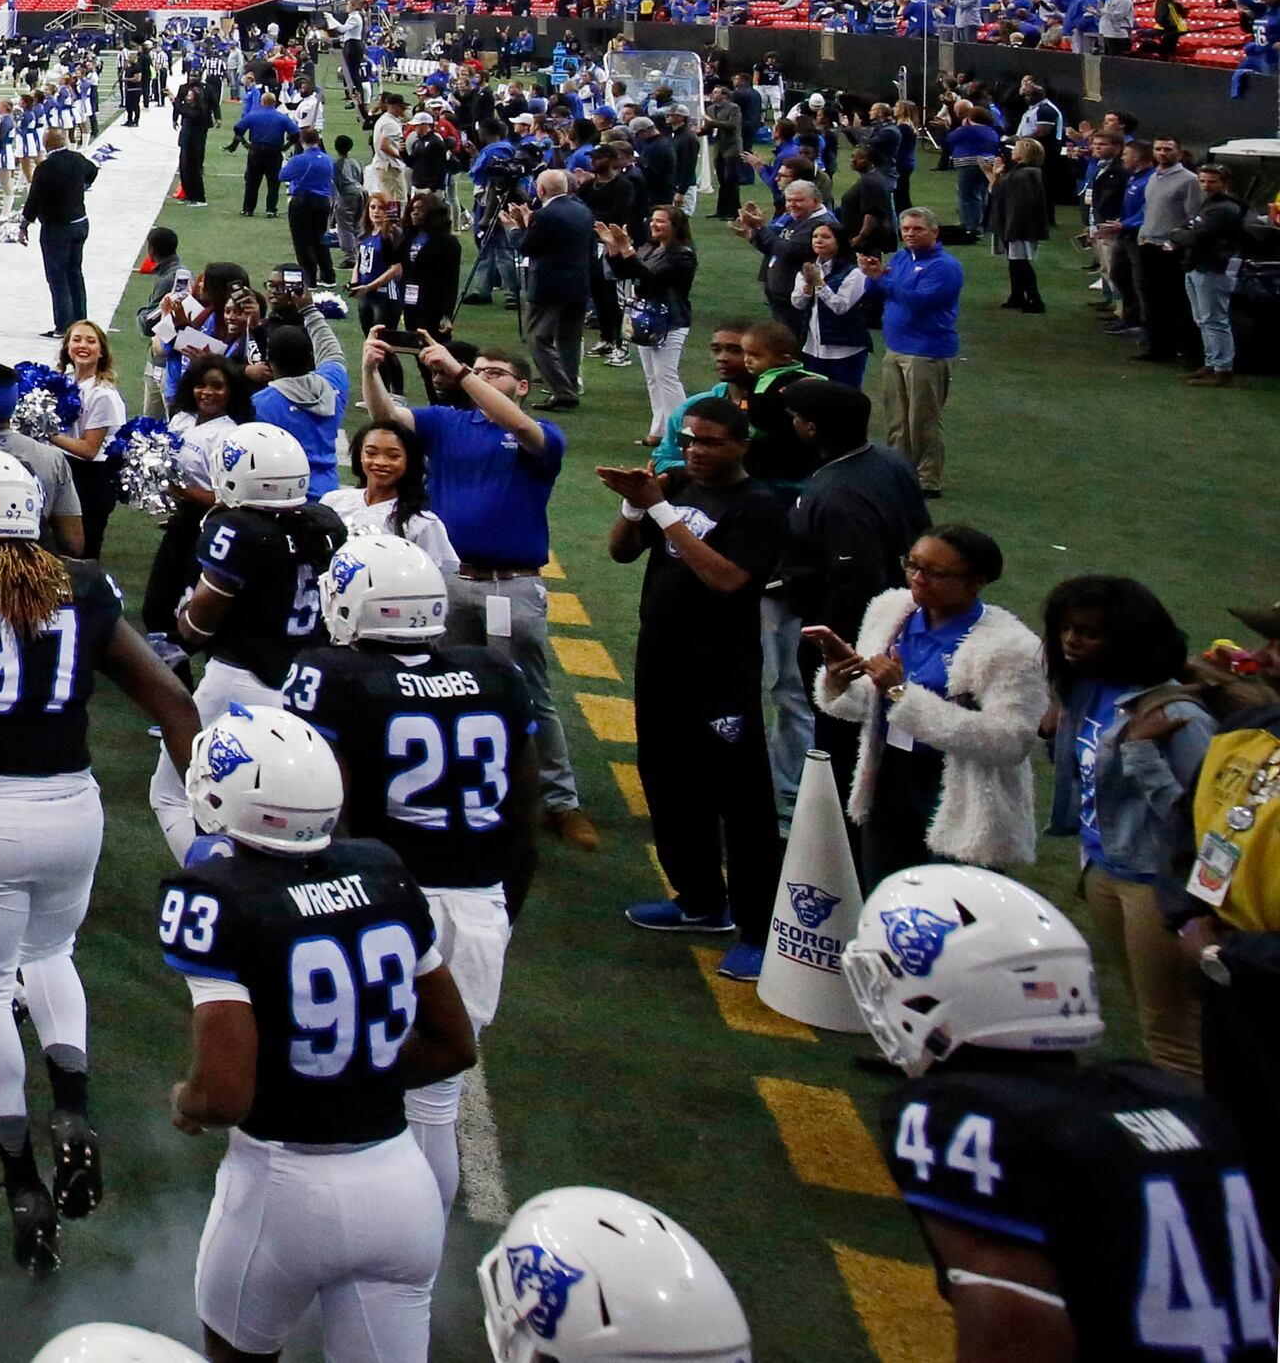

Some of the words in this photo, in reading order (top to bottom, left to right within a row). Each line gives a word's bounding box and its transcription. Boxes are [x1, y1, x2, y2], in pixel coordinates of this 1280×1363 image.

[208, 524, 237, 561] 5
[283, 663, 322, 713] 23
[396, 671, 480, 699] STUBBS
[385, 712, 511, 833] 23
[157, 887, 221, 955] 93
[286, 874, 372, 917] WRIGHT
[777, 935, 842, 970] STATE
[288, 919, 422, 1082] 93
[893, 1100, 1003, 1197] 44
[1133, 1167, 1280, 1363] 44
